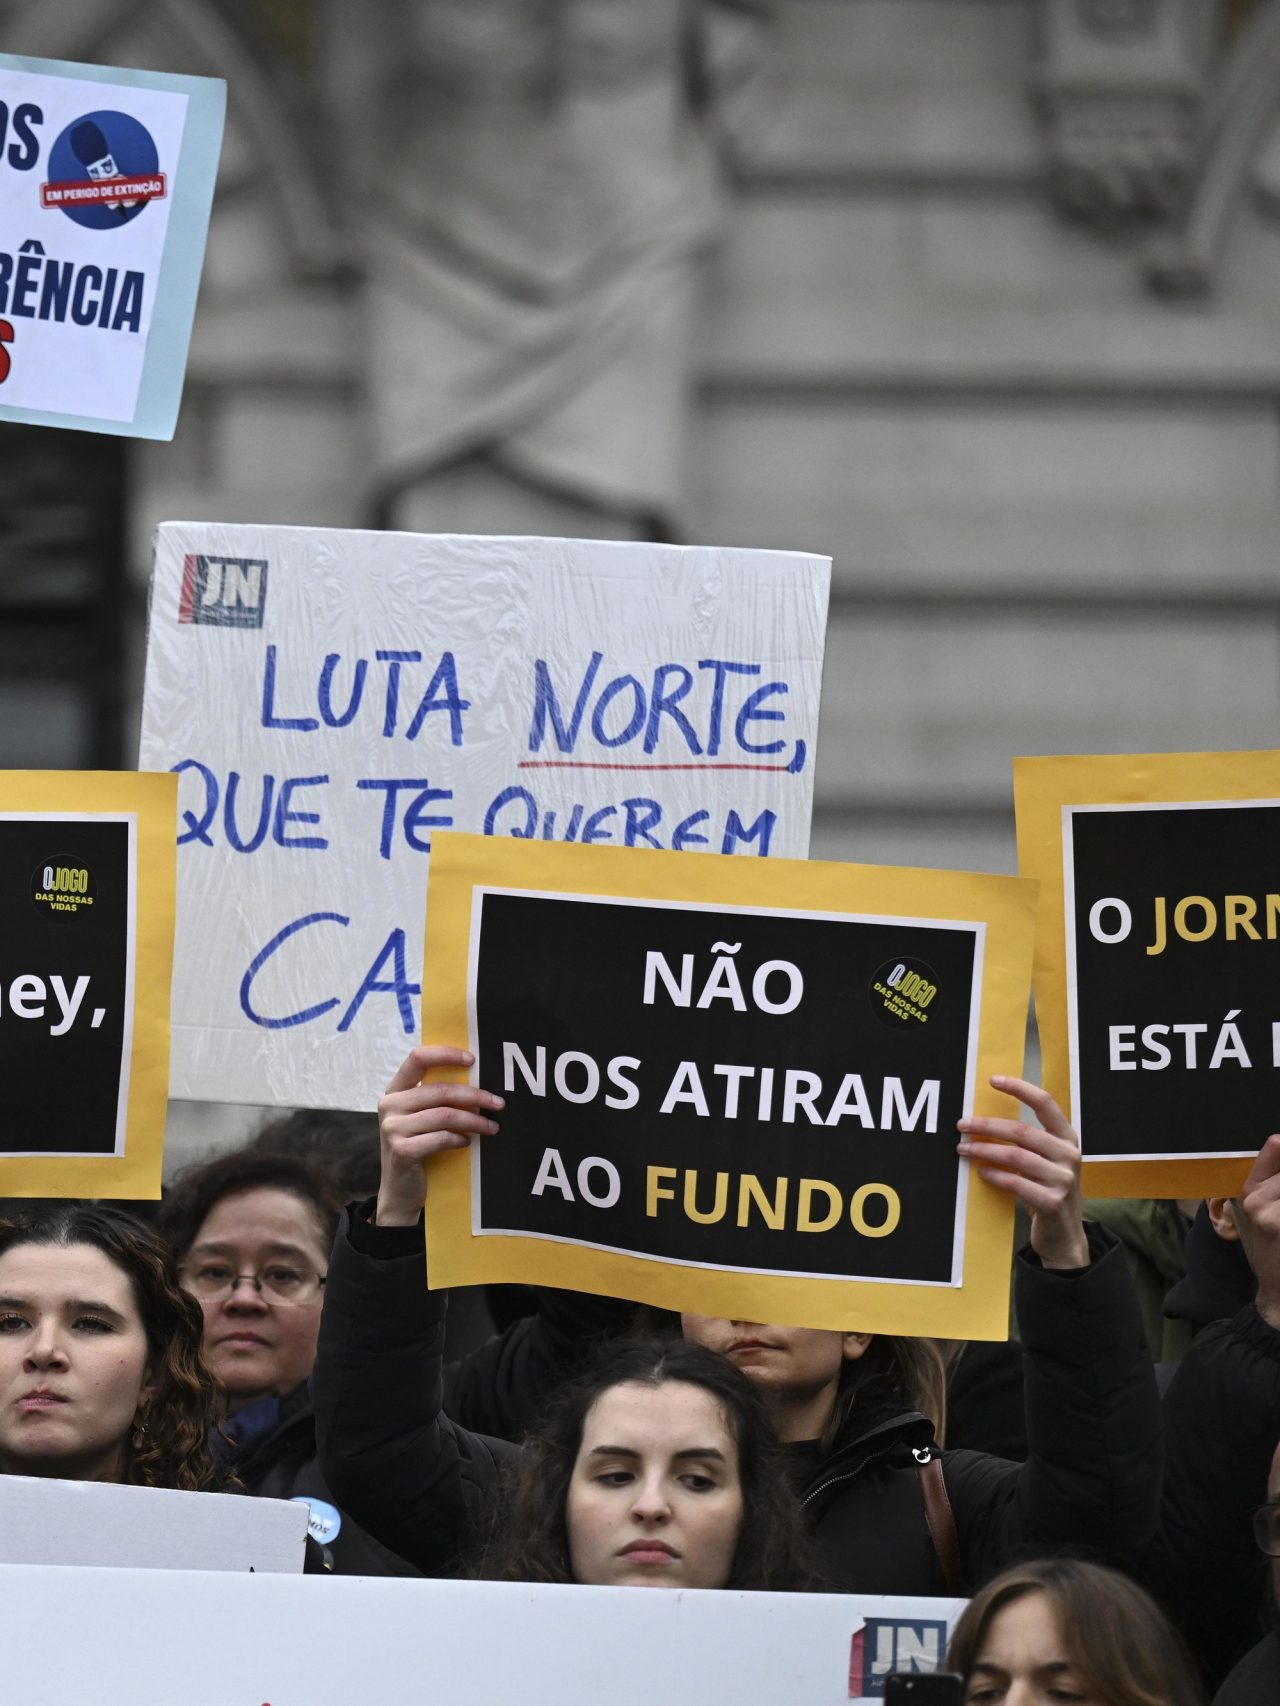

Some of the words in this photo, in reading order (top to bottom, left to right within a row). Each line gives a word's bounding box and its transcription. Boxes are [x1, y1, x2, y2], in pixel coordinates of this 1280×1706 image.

[46, 190, 62, 201] EM
[63, 186, 100, 199] PERIGO
[101, 185, 113, 197] DE
[115, 180, 162, 195] EXTINÇÃO
[202, 563, 261, 608] JN
[261, 645, 472, 747] LUTA
[528, 651, 807, 775] NORTE,
[169, 758, 330, 854] QUE
[356, 778, 454, 861] TE
[35, 892, 54, 901] DAS
[56, 894, 94, 905] NOSSAS
[50, 902, 78, 912] VIDAS
[1088, 897, 1132, 944] O
[643, 940, 805, 1015] NÃO
[873, 982, 893, 998] DAS
[892, 995, 928, 1022] NOSSAS
[883, 999, 909, 1020] VIDAS
[1108, 1009, 1253, 1071] ESTÁ
[503, 1041, 642, 1111] NOS
[659, 1061, 942, 1135] ATIRAM
[530, 1147, 622, 1209] AO
[645, 1165, 902, 1239] FUNDO
[871, 1626, 939, 1675] JN
